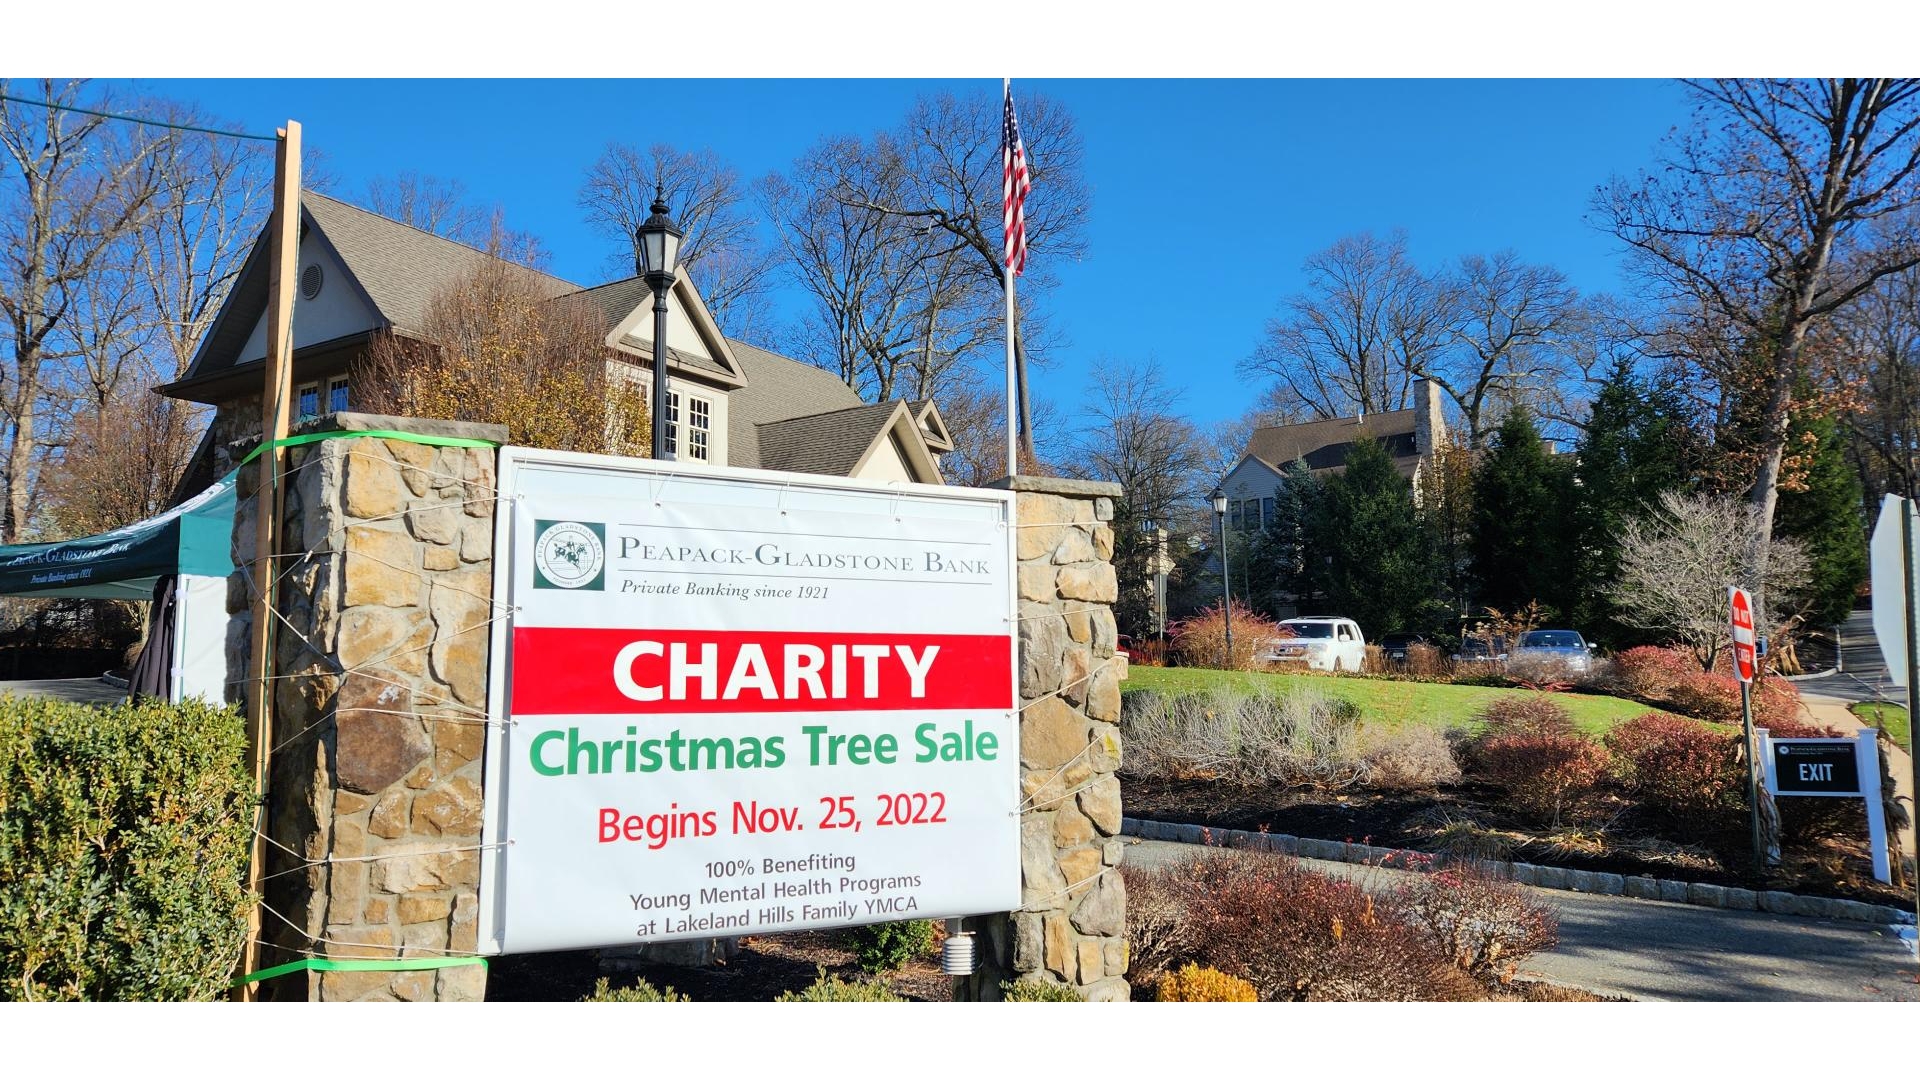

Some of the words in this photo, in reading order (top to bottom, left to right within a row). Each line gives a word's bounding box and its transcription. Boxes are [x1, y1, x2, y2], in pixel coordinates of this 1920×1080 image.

[617, 536, 914, 572] PEAPACK-GLADSTONE
[923, 551, 990, 575] BANK
[620, 579, 681, 595] Private
[685, 581, 750, 601] Banking
[754, 585, 793, 599] since
[797, 585, 829, 600] 1921
[613, 640, 941, 702] CHARITY
[529, 725, 786, 777] Christmas
[802, 725, 899, 767] Tree
[914, 719, 999, 763] Sale
[1799, 763, 1834, 782] EXIT
[598, 803, 717, 850] Begins
[732, 800, 804, 835] Nov.
[819, 796, 862, 833] 25,
[876, 791, 947, 827] 2022
[704, 859, 755, 879] 100%
[762, 853, 856, 875] Benefiting
[629, 892, 691, 912] Young
[700, 881, 767, 905] Mental
[774, 876, 832, 899] Health
[839, 872, 922, 895] Programs
[636, 920, 657, 937] at
[665, 911, 751, 934] Lakeland
[758, 906, 795, 925] Hills
[802, 900, 858, 922] Family
[864, 896, 918, 914] YMCA
